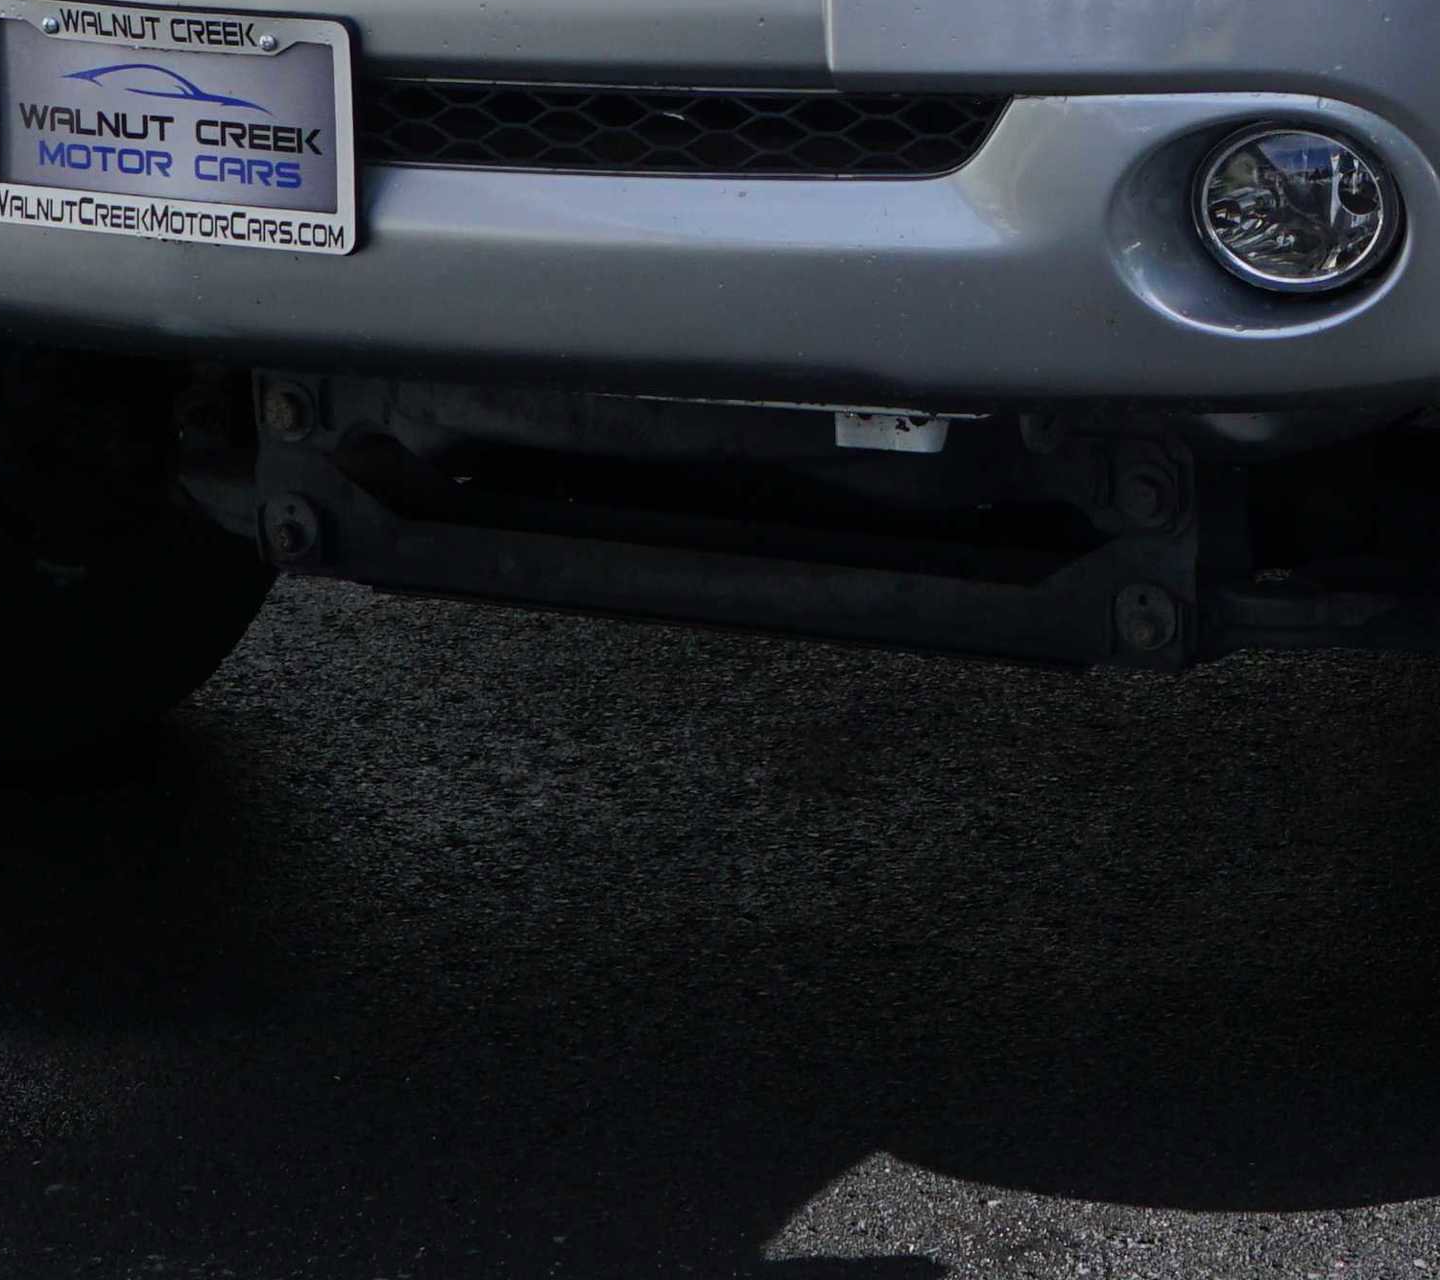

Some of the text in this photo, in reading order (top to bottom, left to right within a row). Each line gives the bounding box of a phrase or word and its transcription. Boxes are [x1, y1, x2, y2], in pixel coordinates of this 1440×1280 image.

[60, 8, 258, 47] WALNUT CREEK
[19, 102, 323, 156] WALNUT CREEK
[39, 140, 303, 189] MOTOR CARS
